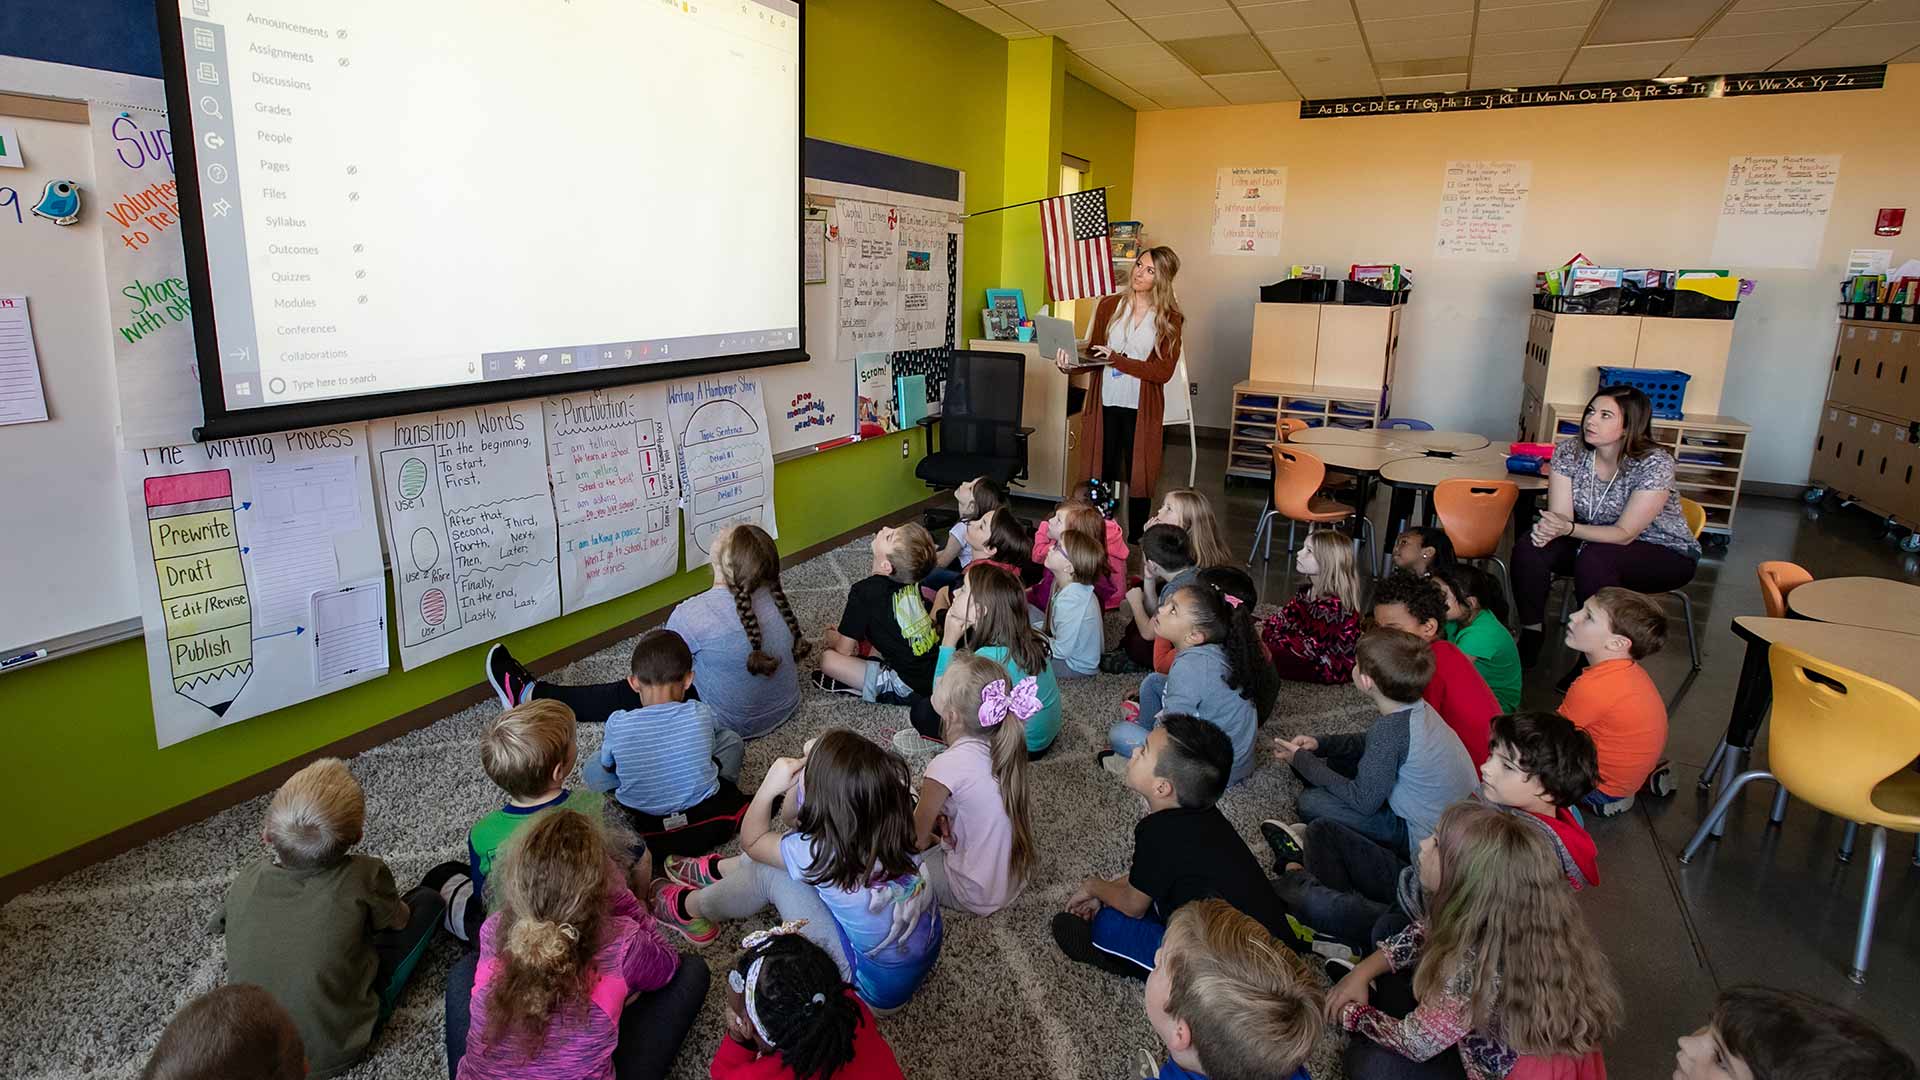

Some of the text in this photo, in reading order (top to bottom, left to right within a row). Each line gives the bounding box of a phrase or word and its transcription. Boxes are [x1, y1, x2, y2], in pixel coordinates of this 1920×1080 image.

[247, 13, 328, 38] Announcements
[249, 43, 314, 63] Assignments
[252, 72, 311, 91] Discussions
[1318, 104, 1332, 114] Aa
[1335, 104, 1348, 114] Bb
[1352, 103, 1366, 112] Cc
[1370, 102, 1384, 112] Dd
[1388, 100, 1400, 111] Ee
[1406, 100, 1418, 110] Ff
[1423, 99, 1438, 112] Gg
[1442, 98, 1456, 108] Hh
[1464, 98, 1472, 108] Ii
[1480, 96, 1494, 109] Jj
[1500, 94, 1514, 104] Kk
[1521, 92, 1532, 104] Ll
[1536, 92, 1556, 103] Mm
[1560, 91, 1574, 101] Nn
[1579, 90, 1597, 100] Oo
[1601, 88, 1616, 102] Pp
[1622, 87, 1640, 101] Qq
[1645, 86, 1661, 96] Rr
[1668, 84, 1683, 95] Ss
[1691, 83, 1706, 94] Tt
[1738, 80, 1753, 91] Vv
[1759, 79, 1781, 90] Ww
[1784, 78, 1804, 88] Xx
[1810, 76, 1827, 91] Yy
[1835, 75, 1855, 86] Zz
[255, 102, 292, 116] Grades
[258, 131, 293, 145] People
[260, 160, 290, 173] Pages
[263, 188, 287, 200] Files
[266, 216, 306, 228] Syllabus
[121, 231, 149, 250] to
[269, 243, 319, 255] Outcomes
[272, 272, 311, 282] Quizzes
[122, 276, 189, 315] Share
[274, 298, 316, 309] Modules
[120, 311, 167, 344] with
[277, 324, 336, 336] Conferences
[280, 349, 348, 362] Collaborations
[294, 374, 376, 390] Type here to search
[668, 376, 757, 406] Writing A Hamburger Story
[561, 393, 628, 425] Punctuation
[394, 406, 525, 447] Transition Words
[699, 426, 744, 442] Topic Sentence
[204, 436, 276, 463] Writing
[286, 428, 354, 452] Process
[438, 436, 532, 458] In the beginning,
[552, 438, 617, 456] I am telling
[438, 457, 486, 473] To start,
[709, 452, 726, 462] Detail
[445, 472, 481, 489] First,
[556, 470, 567, 485] I
[576, 471, 590, 481] am
[714, 473, 731, 484] Detail
[560, 499, 570, 513] I
[577, 500, 590, 510] am
[450, 514, 476, 528] After
[504, 515, 538, 529] Third,
[159, 518, 231, 547] Prewrite
[452, 528, 494, 541] Second,
[510, 530, 536, 544] Next,
[453, 540, 490, 555] Fourth,
[566, 540, 574, 553] I
[578, 540, 590, 550] am
[591, 533, 613, 546] taking
[166, 558, 213, 587] Draft
[462, 577, 495, 593] Finally,
[170, 594, 248, 620] Edit/Revise
[460, 597, 476, 609] In
[479, 590, 493, 602] the
[176, 634, 232, 666] Publish
